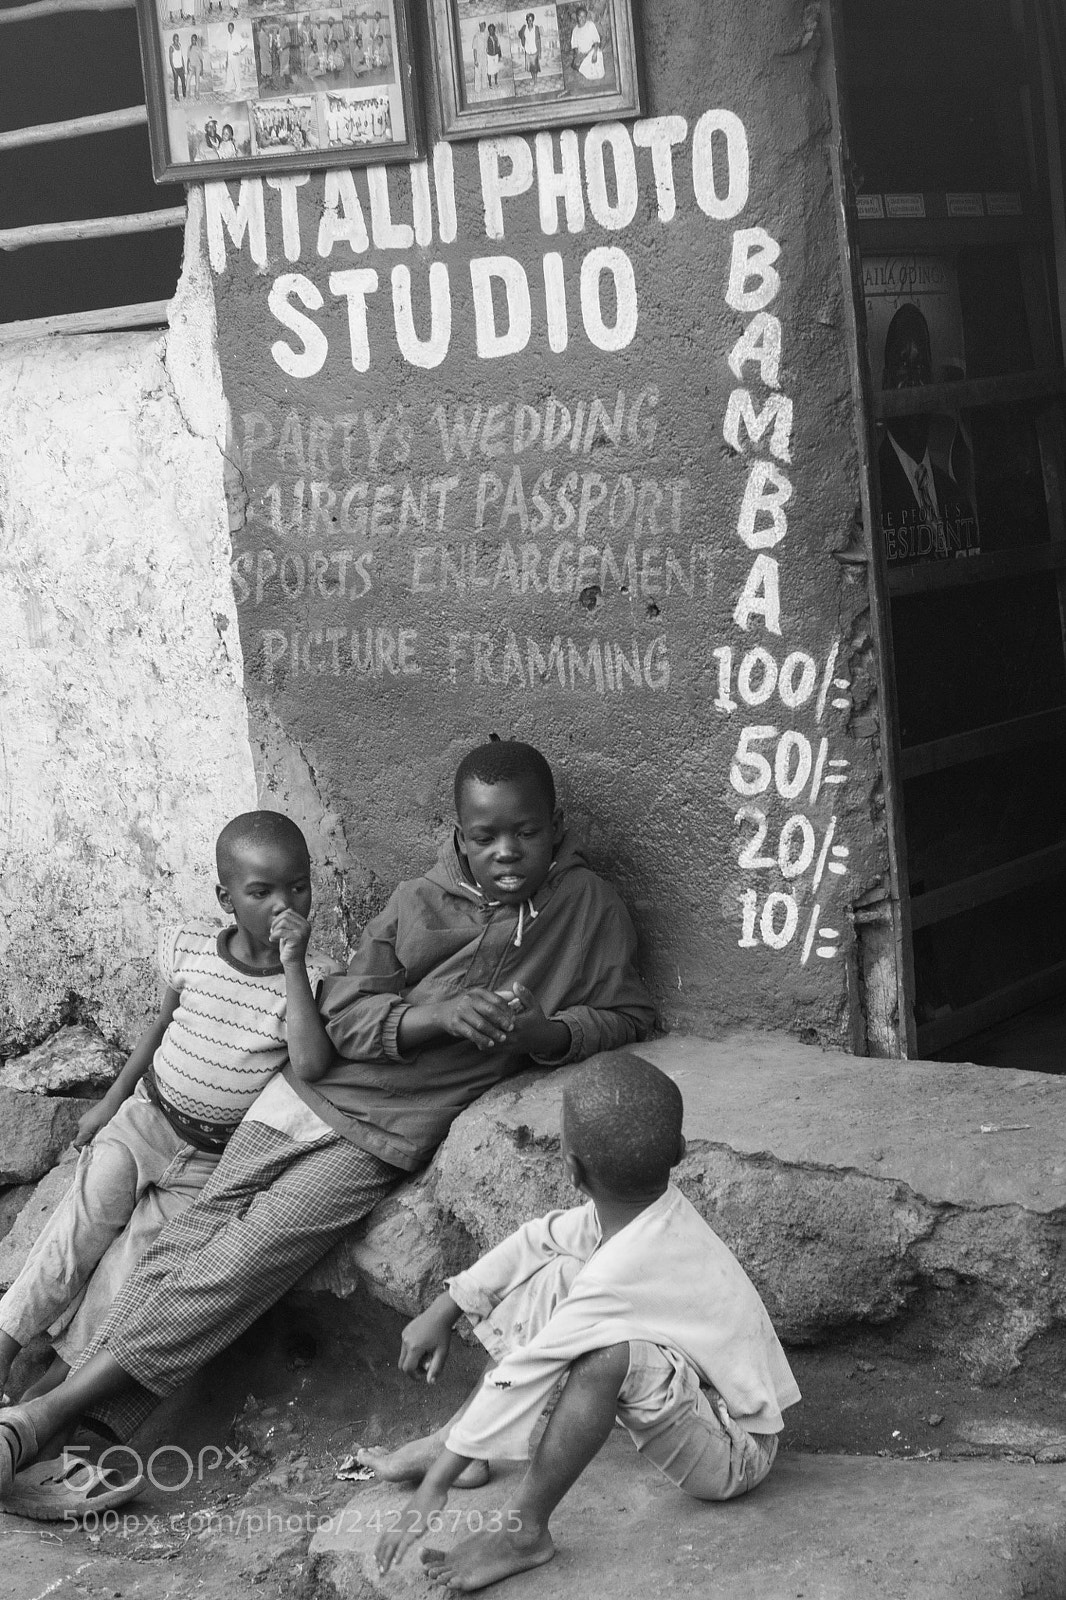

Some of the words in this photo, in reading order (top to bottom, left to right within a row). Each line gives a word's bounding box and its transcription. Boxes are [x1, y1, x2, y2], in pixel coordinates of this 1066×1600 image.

[204, 140, 457, 274] MTALII
[477, 108, 750, 240] PHOTO
[267, 246, 639, 379] STUDIO
[864, 266, 896, 287] AILA
[433, 384, 660, 462] WEDDING
[723, 227, 793, 635] BAMBA
[265, 475, 461, 537] URGENT
[476, 465, 692, 540] PASSPORT
[883, 516, 975, 560] ESIDENT
[231, 549, 374, 602] SPORTS
[261, 627, 422, 685] PICTURE
[713, 638, 850, 724] 100/=
[730, 725, 849, 805] 50/=
[734, 807, 849, 894] 20/=
[738, 888, 839, 965] 10/=
